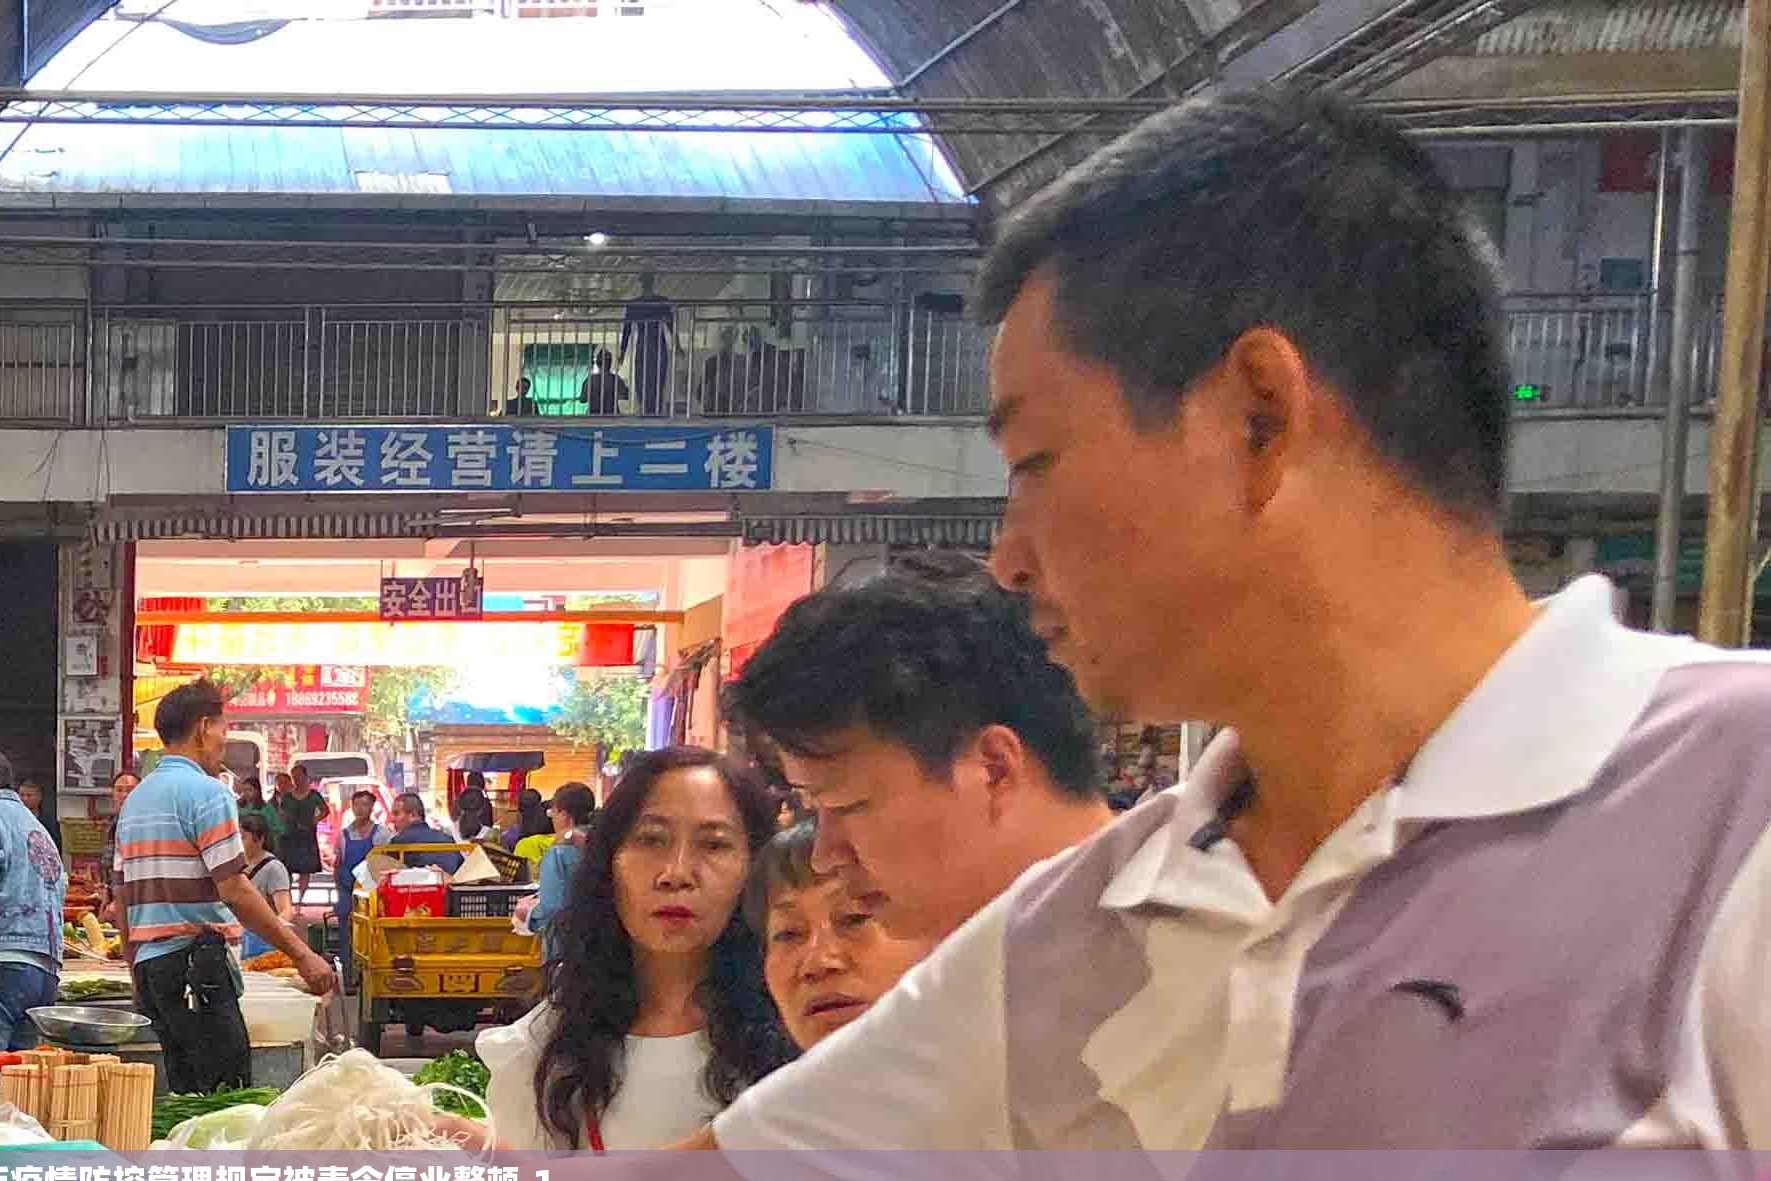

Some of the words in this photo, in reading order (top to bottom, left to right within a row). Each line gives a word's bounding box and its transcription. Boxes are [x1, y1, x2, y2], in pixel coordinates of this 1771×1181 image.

[247, 429, 760, 489] 服装经营请上二楼
[382, 580, 482, 618] 安全出口
